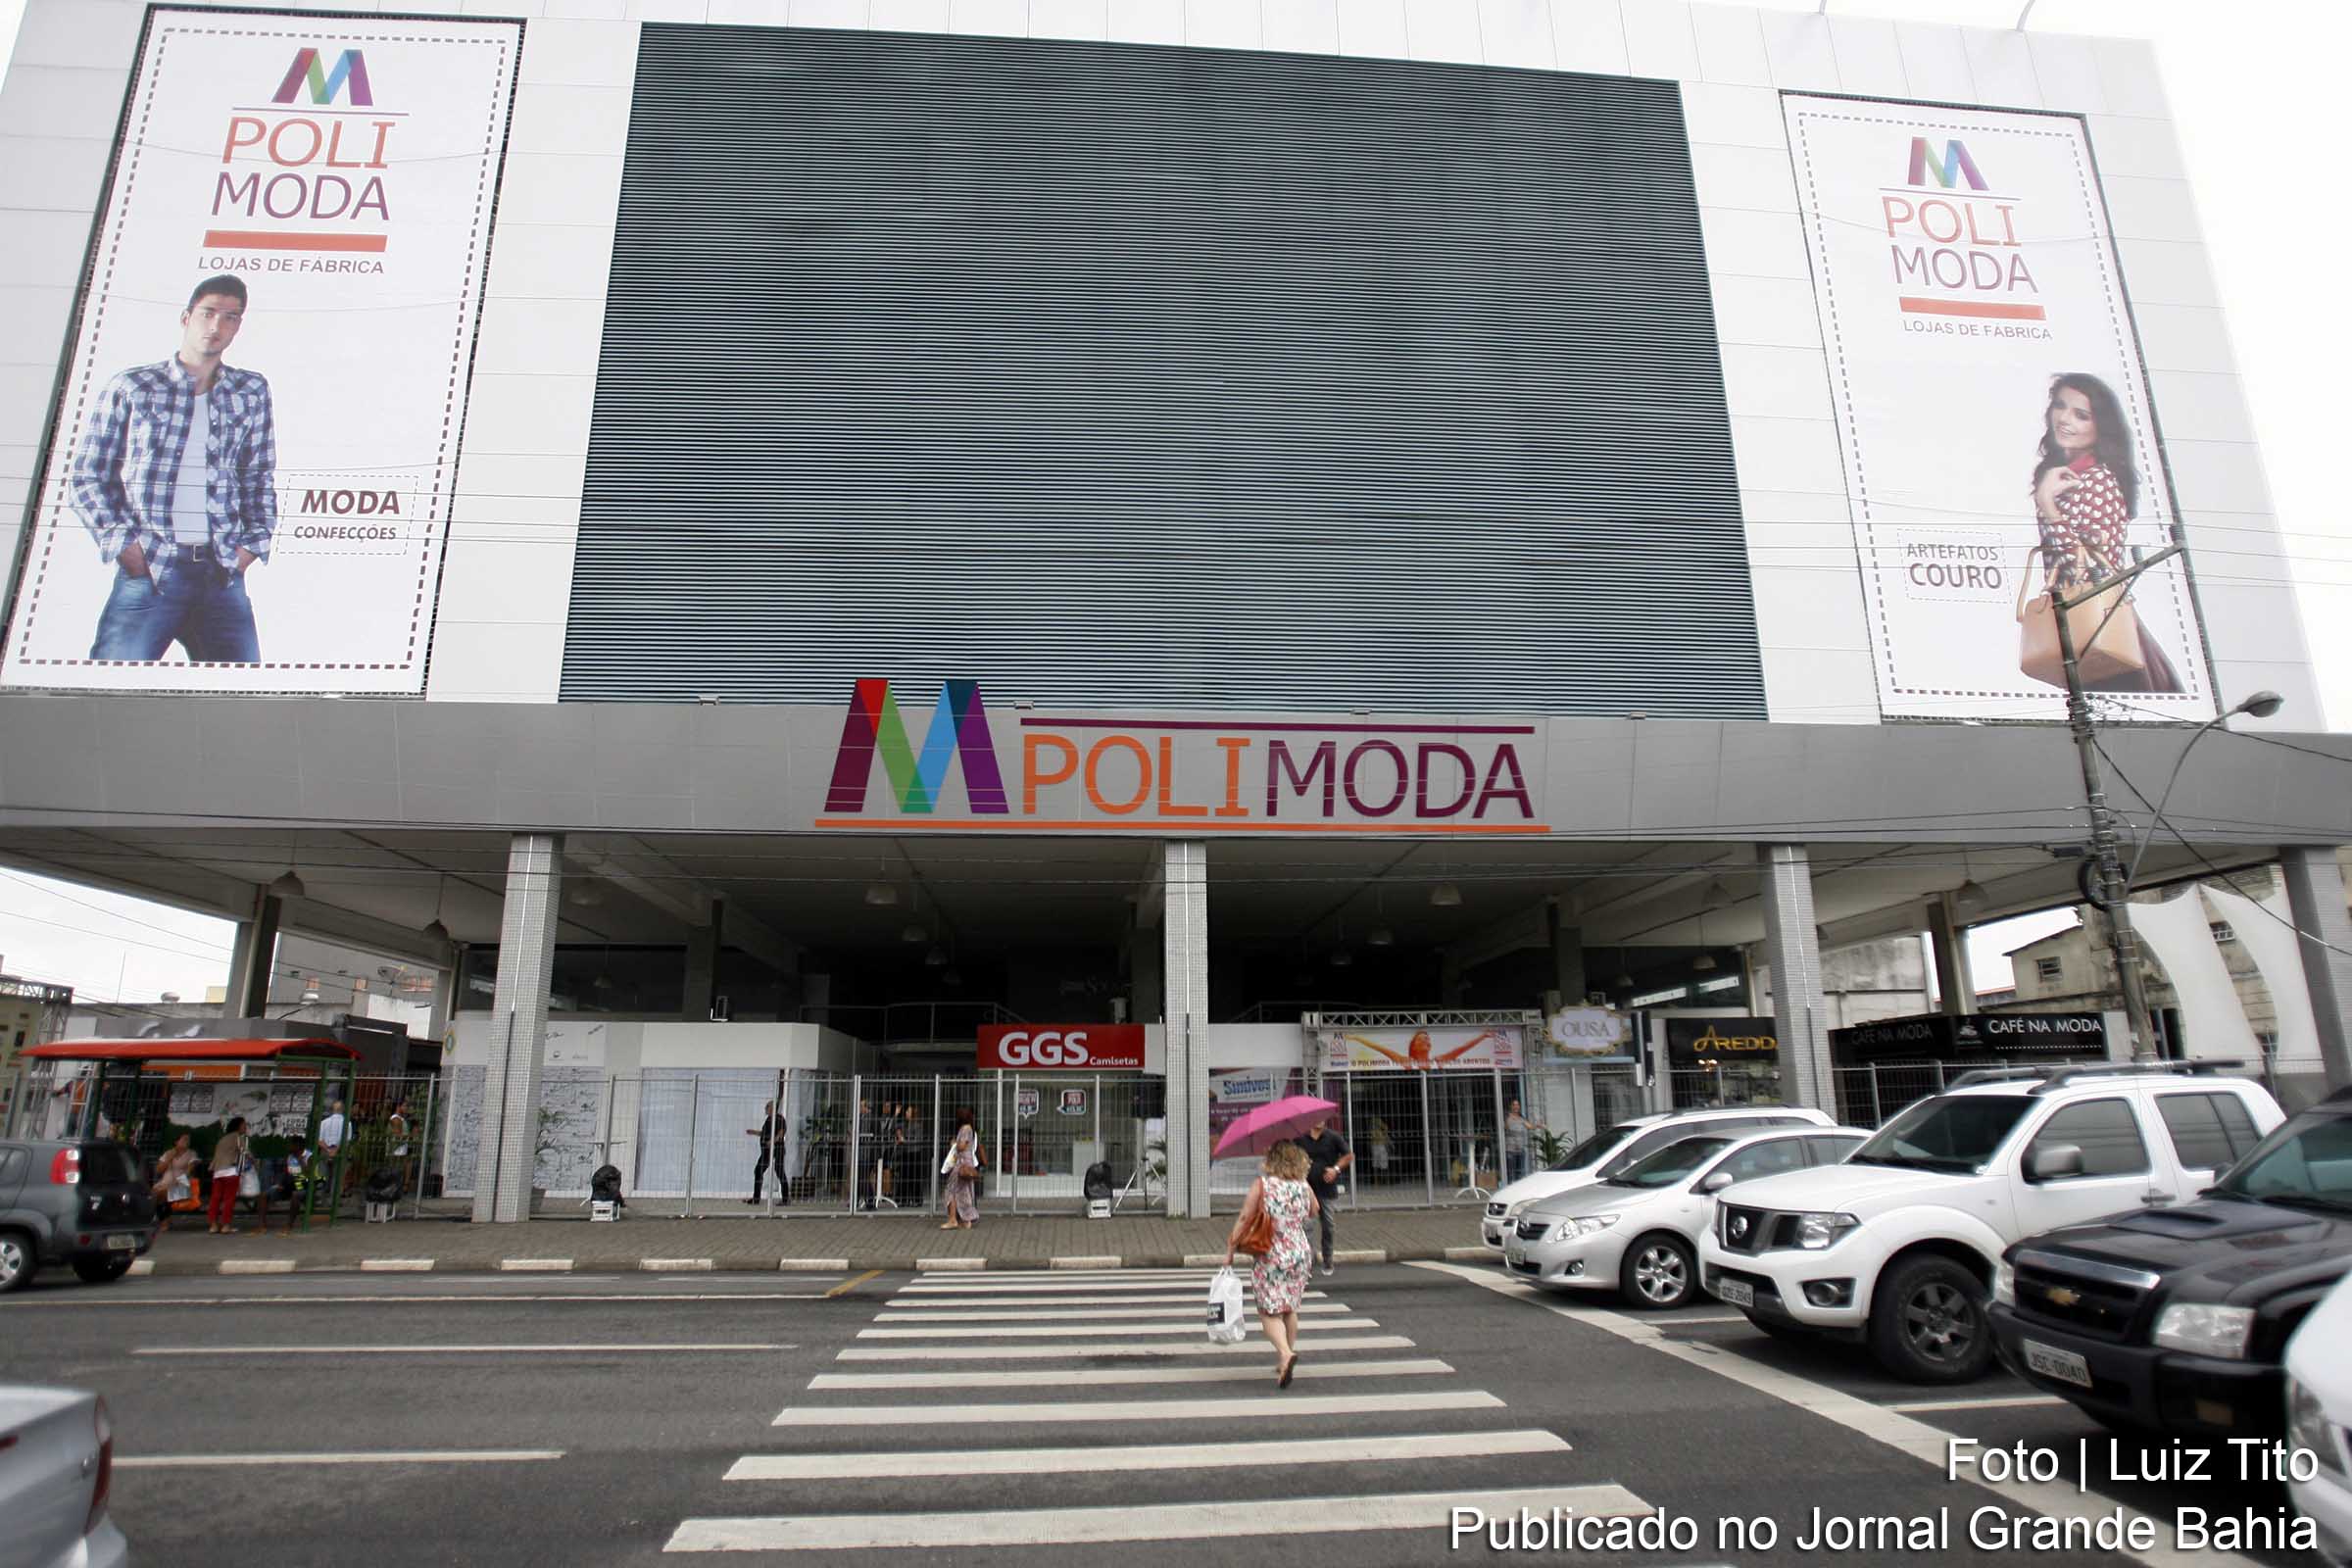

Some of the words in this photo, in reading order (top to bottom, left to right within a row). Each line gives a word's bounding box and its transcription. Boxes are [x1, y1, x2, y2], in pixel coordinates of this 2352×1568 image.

[222, 116, 396, 169] POLI
[211, 172, 390, 220] MODA
[1882, 196, 2022, 247] POLI
[198, 256, 262, 271] LOJAS
[268, 258, 293, 271] DE
[300, 256, 384, 274] FÁBRICA
[1891, 244, 2039, 294] MODA
[1903, 318, 1955, 335] LOJAS
[1959, 323, 1980, 336] DE
[300, 489, 401, 515] MODA
[294, 523, 397, 543] CONFECÇÕES
[1907, 543, 1999, 561] ARTEFATOS
[1910, 563, 2002, 590] COURO
[1896, 1023, 1935, 1041] MODA
[1988, 1015, 2025, 1034] CAFÉ
[2029, 1018, 2052, 1033] NA
[2056, 1018, 2103, 1033] MODA
[998, 1031, 1089, 1066] GGS
[1090, 1055, 1139, 1066] Camisetas
[1693, 1024, 1778, 1052] AREDD
